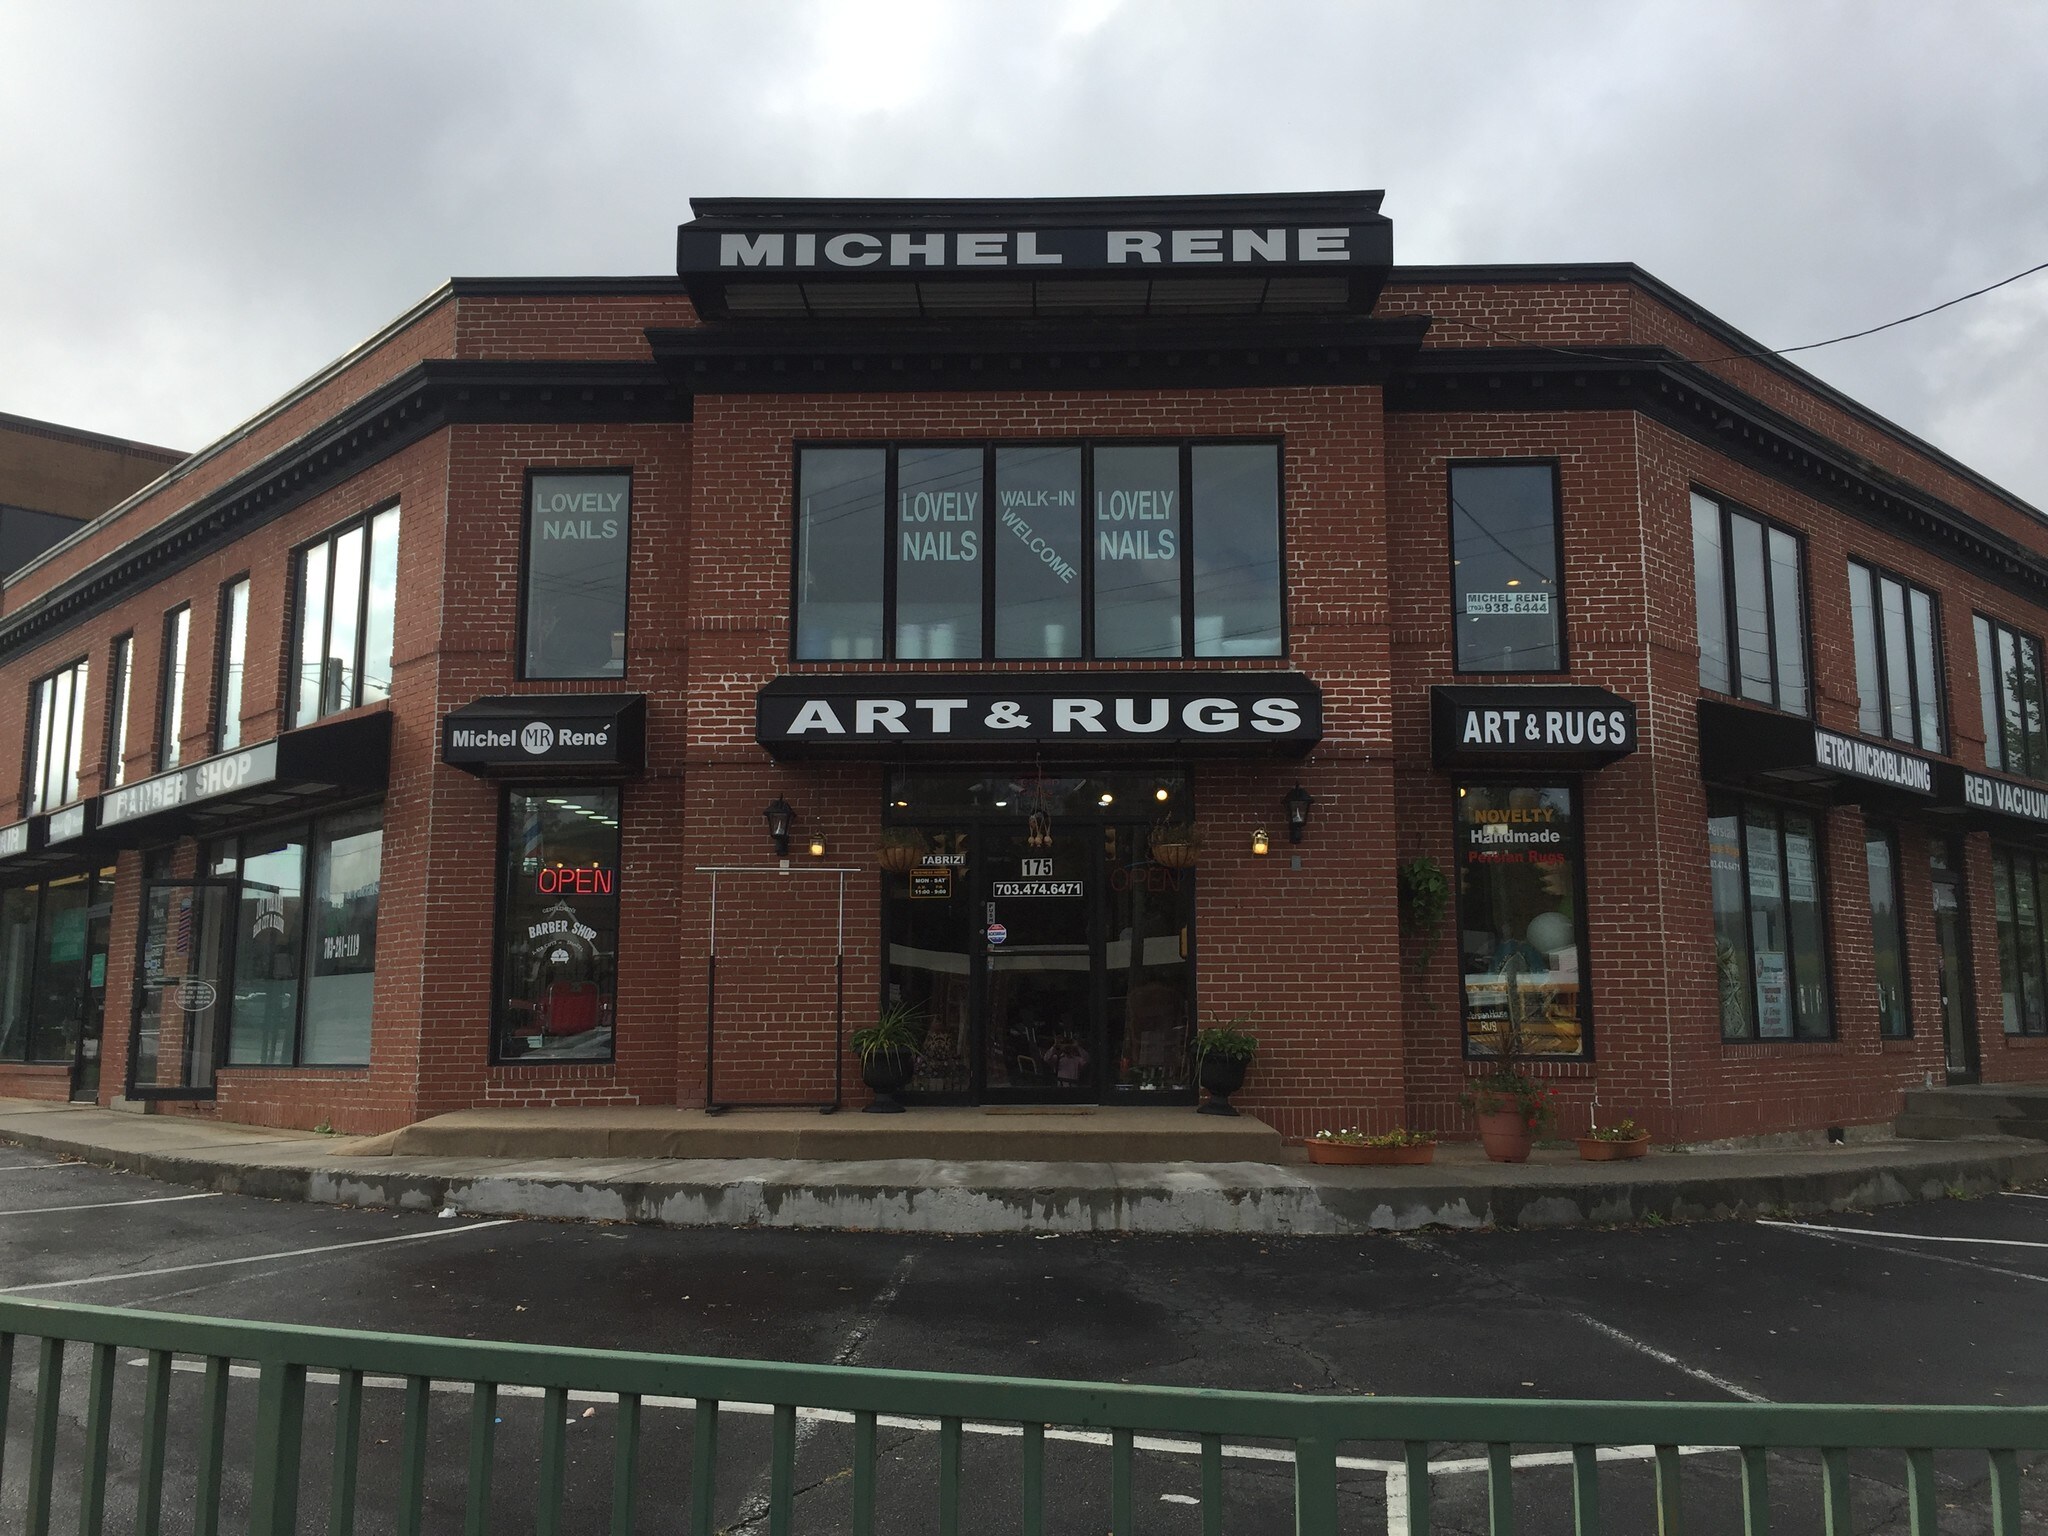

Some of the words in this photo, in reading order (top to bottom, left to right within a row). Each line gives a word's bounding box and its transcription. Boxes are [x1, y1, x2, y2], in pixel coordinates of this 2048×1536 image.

[720, 233, 1063, 268] MICHEL
[1107, 228, 1351, 264] RENE
[536, 493, 623, 513] LOVELY
[902, 492, 978, 523] LOVELY
[1000, 490, 1076, 507] WALK-IN
[1098, 490, 1174, 521] LOVELY
[543, 519, 618, 540] NAILS
[903, 530, 978, 562] NAILS
[1001, 507, 1078, 584] WELCOME
[1100, 529, 1176, 561] NAILS
[1467, 594, 1512, 602] MICHEL
[1516, 594, 1547, 602] RENE
[1484, 603, 1548, 613] 938-6444
[786, 699, 968, 734] ART
[984, 700, 1032, 730] &
[1052, 697, 1302, 734] RUGS
[452, 729, 517, 747] Michel
[524, 729, 553, 747] MR
[1462, 710, 1521, 744] ART
[1524, 713, 1541, 741] &
[1546, 710, 1627, 745] RUGS
[1814, 730, 1853, 771] METRO
[1853, 742, 1931, 792] MICROBLADING
[195, 752, 252, 797] SHOP
[1964, 773, 1993, 808] RED
[1474, 808, 1554, 823] NOVELTY
[1470, 828, 1561, 844] Handmade
[922, 855, 965, 865] TABRIZI
[1024, 859, 1052, 876] 175
[1527, 849, 1566, 865] Rugs
[538, 868, 612, 894] OPEN
[995, 883, 1081, 896] 703.474.6471
[1110, 868, 1181, 892] OPEN
[528, 919, 569, 939] BARBER
[571, 921, 598, 942] SHOP
